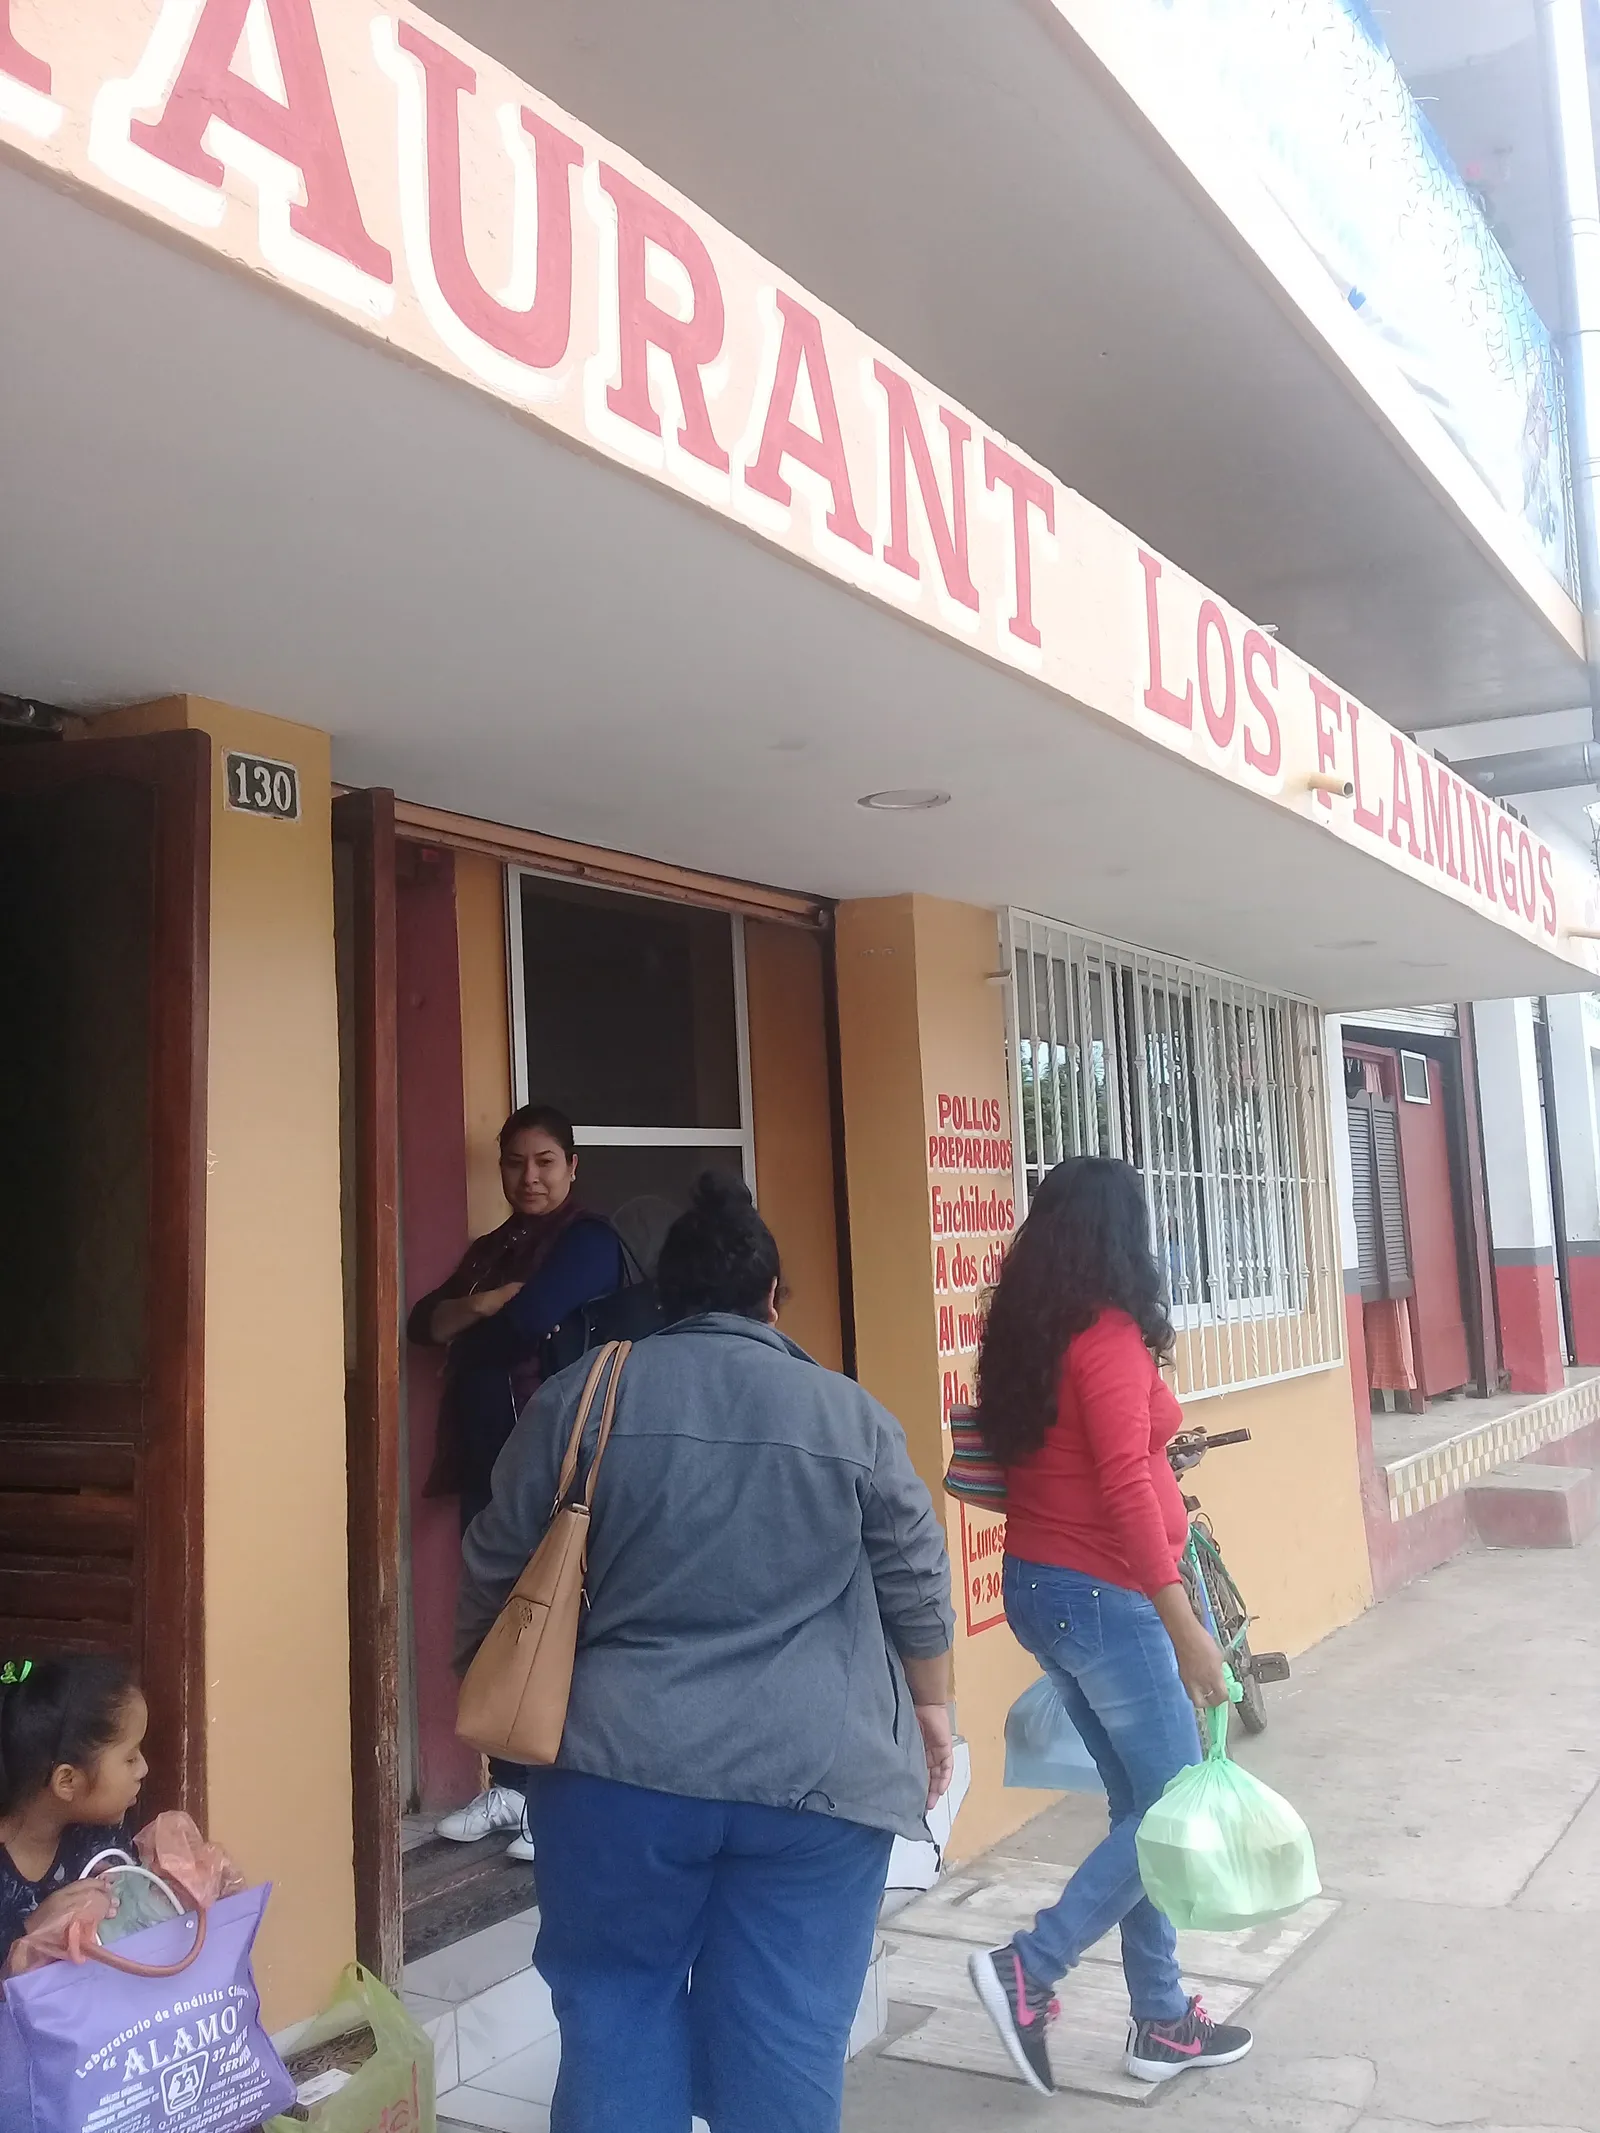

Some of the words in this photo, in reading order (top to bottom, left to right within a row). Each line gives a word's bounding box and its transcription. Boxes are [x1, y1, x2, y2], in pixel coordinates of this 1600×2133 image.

[0, 0, 1056, 648] AURANT
[1138, 548, 1282, 777] LOS
[1309, 673, 1557, 938] FLAMINGOS
[235, 762, 292, 812] 130
[937, 1094, 1000, 1133] POLLOS
[929, 1135, 1012, 1171] PREPARADOS
[931, 1185, 1015, 1234] Enchilados
[936, 1247, 948, 1289] A
[952, 1243, 978, 1288] dos
[939, 1305, 955, 1352] Al
[968, 1522, 1004, 1562] Lunes
[75, 2019, 151, 2079] Laboratorio
[154, 2008, 170, 2023] de
[173, 1989, 224, 2016] Análisis
[212, 2047, 226, 2062] 37
